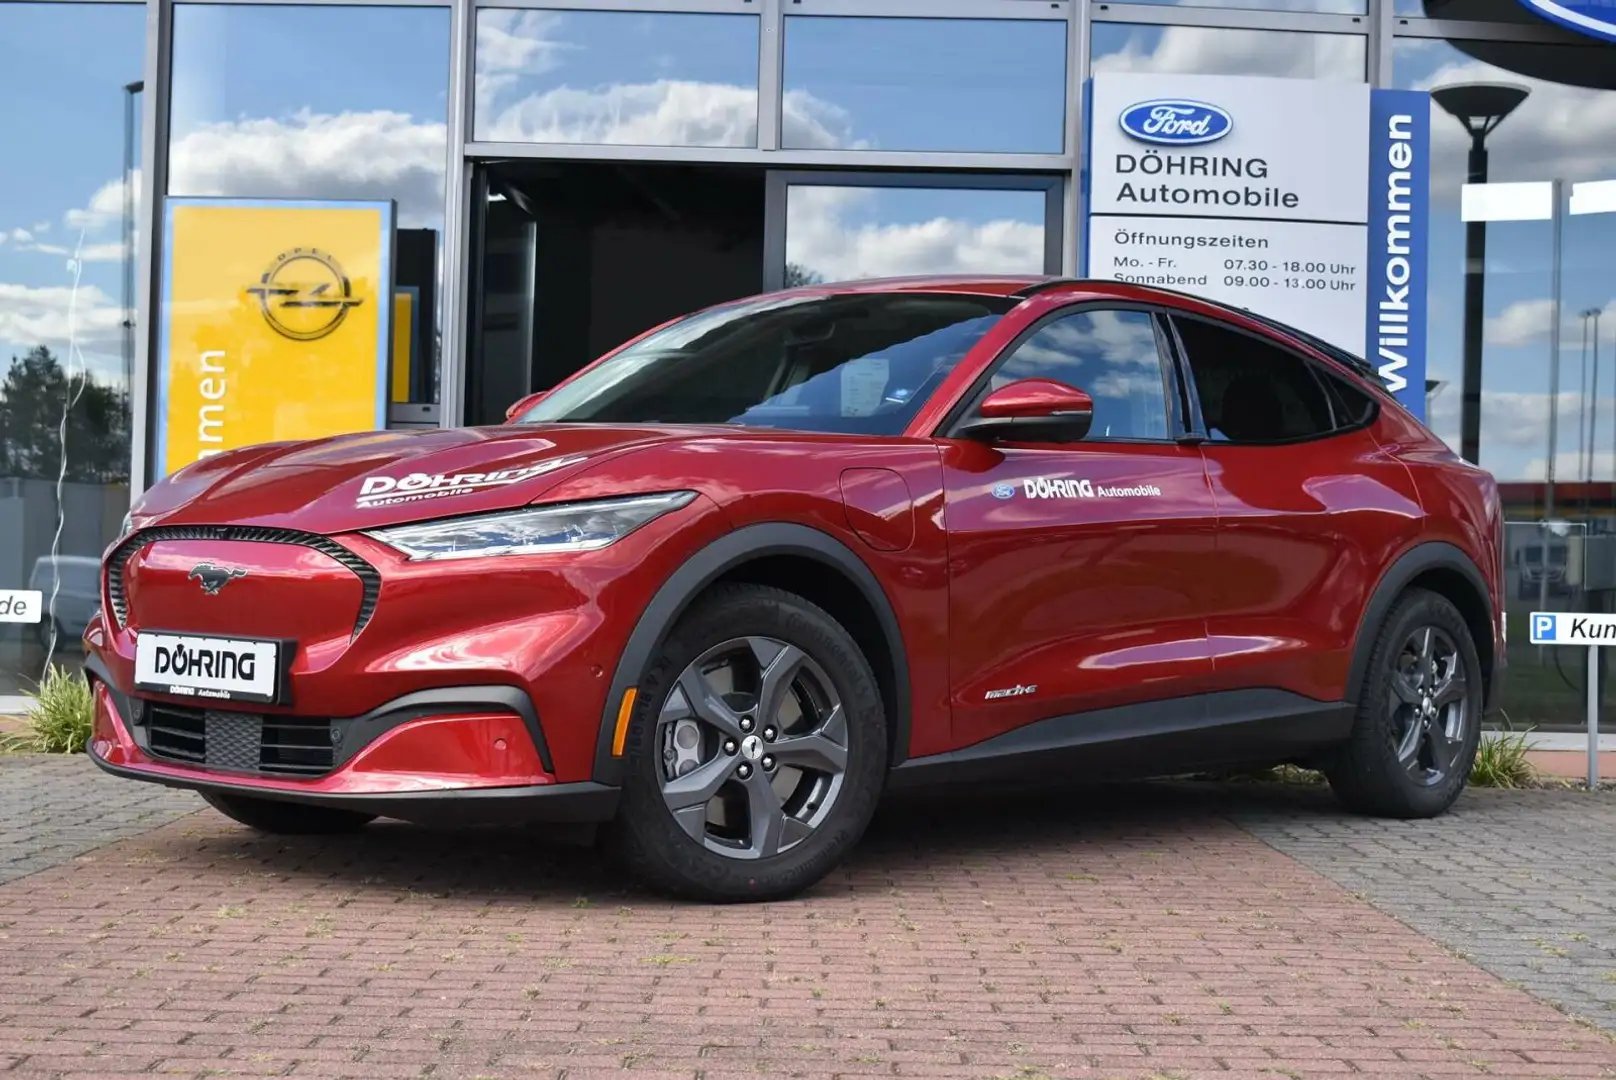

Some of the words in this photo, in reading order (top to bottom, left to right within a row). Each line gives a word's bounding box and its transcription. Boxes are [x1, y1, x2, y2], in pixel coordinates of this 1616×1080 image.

[1143, 106, 1212, 135] Ford
[1115, 150, 1268, 178] DÖHRING
[1116, 182, 1299, 208] Automobile
[1114, 228, 1269, 249] Öffnungszeiten
[1378, 113, 1413, 393] Willkommen
[1113, 256, 1144, 268] Mo.
[1157, 257, 1177, 268] Fr.
[1223, 258, 1268, 271] 07.30
[1282, 261, 1326, 274] 18.00
[1329, 262, 1356, 275] Uhr
[1113, 272, 1208, 286] Sonnabend
[1223, 275, 1270, 288] 09.00
[1283, 277, 1327, 290] 13.00
[1329, 279, 1356, 292] Uhr
[355, 486, 474, 509] Automobile
[1097, 484, 1162, 498] Automobile
